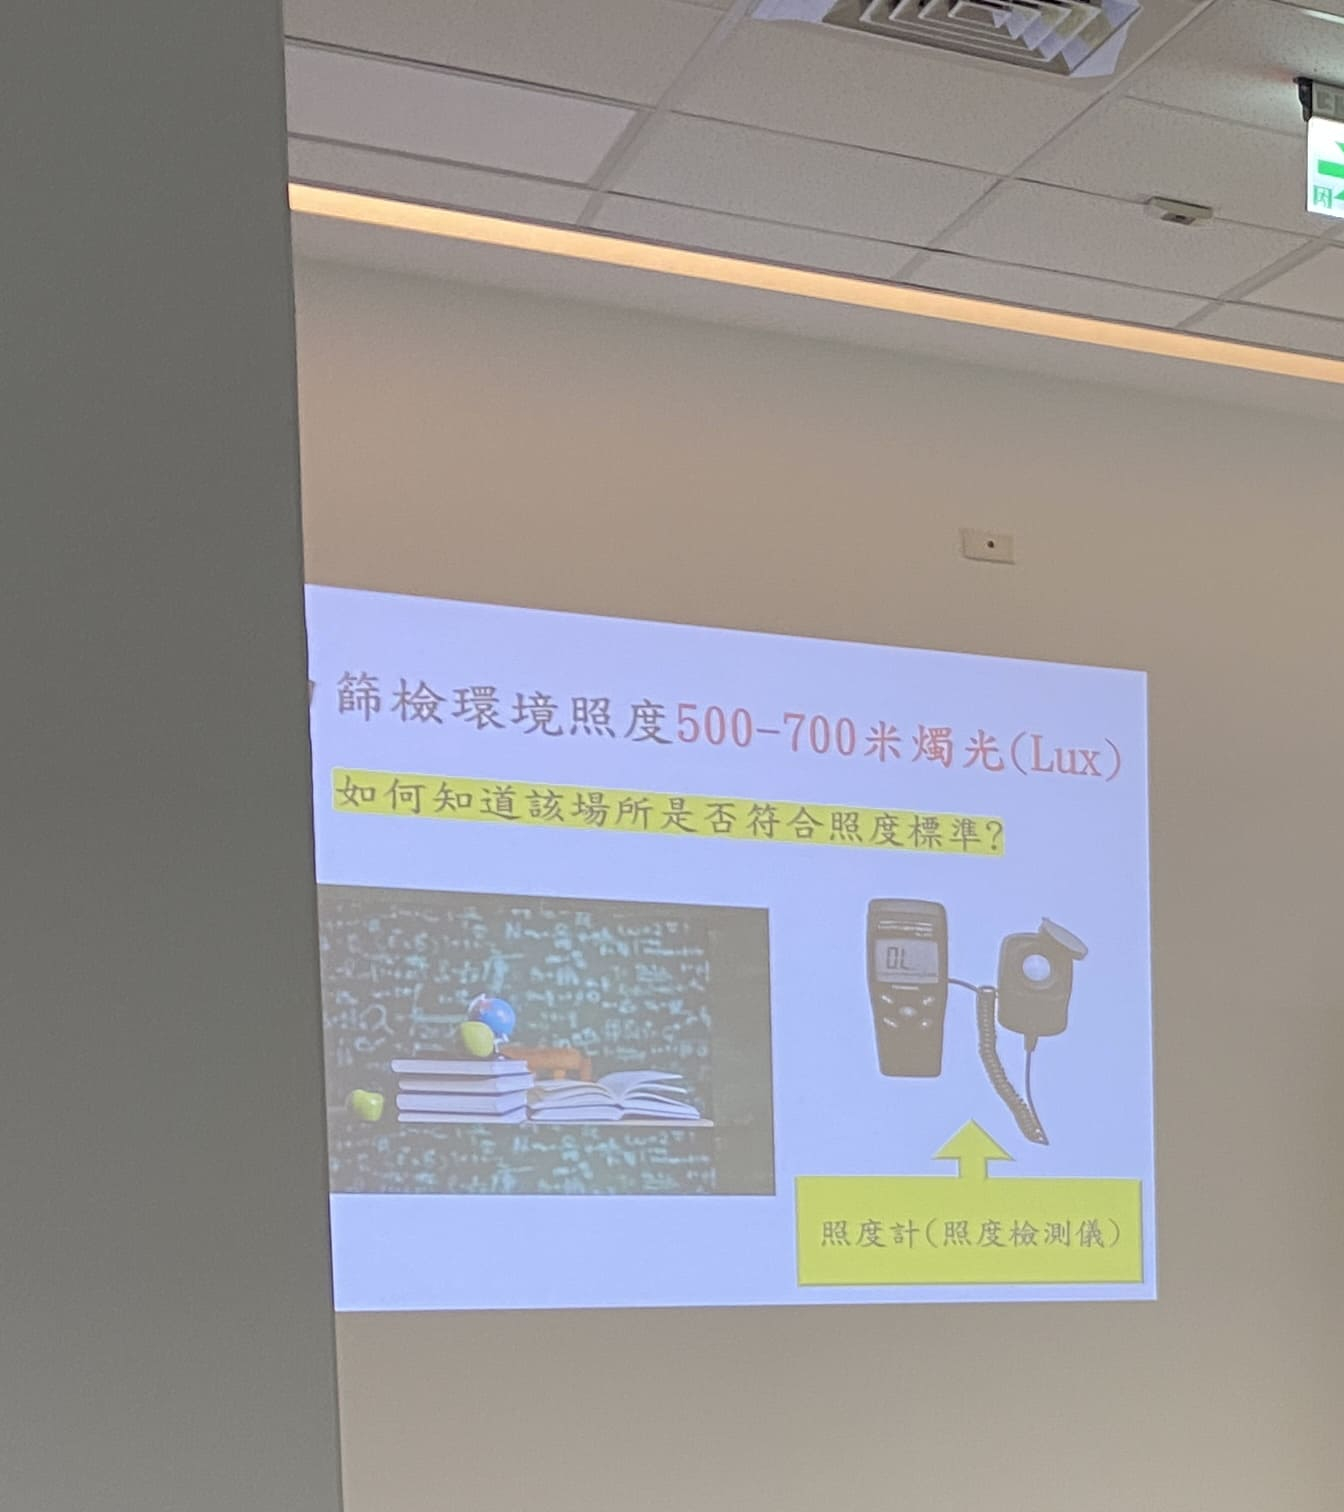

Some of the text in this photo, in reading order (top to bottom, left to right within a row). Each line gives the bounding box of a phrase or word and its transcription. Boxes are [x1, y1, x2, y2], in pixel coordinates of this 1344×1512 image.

[307, 670, 1121, 782] 篩檢環境照度500-700米燭光(Lux)
[335, 775, 1003, 852] 如何知道該場所是否符合照度標準?
[820, 1217, 1120, 1249] 照度計(照度檢測儀)
